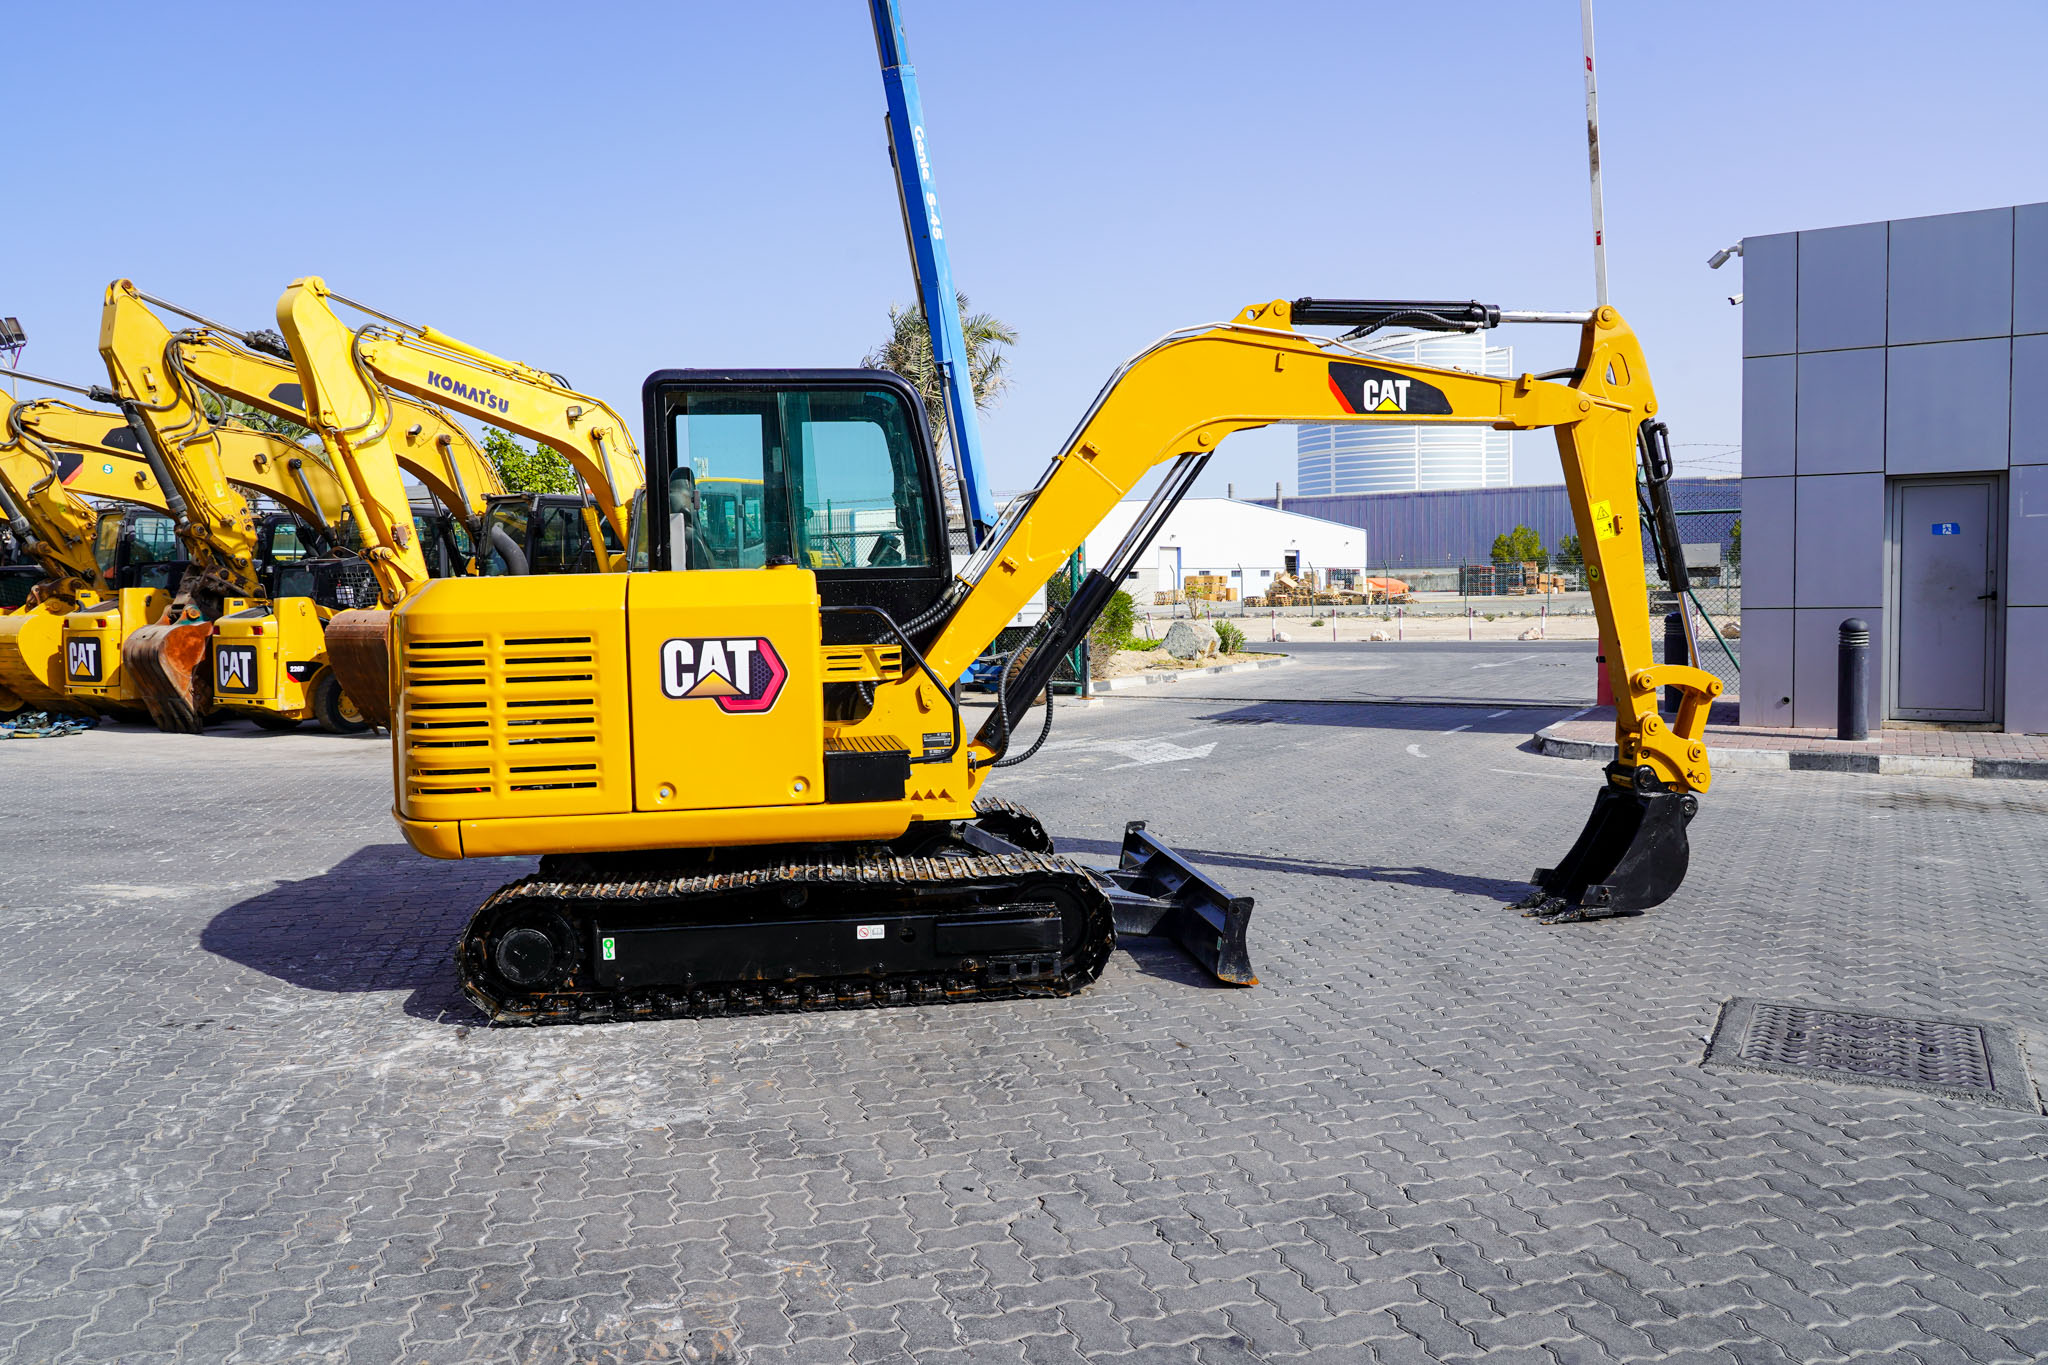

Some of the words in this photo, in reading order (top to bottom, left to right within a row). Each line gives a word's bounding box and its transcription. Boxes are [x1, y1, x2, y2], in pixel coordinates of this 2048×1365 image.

[914, 125, 930, 181] Genie
[926, 191, 943, 240] S-45
[427, 370, 509, 413] KOMATSU
[1363, 379, 1411, 411] CAT
[68, 641, 97, 677] CAT
[219, 650, 252, 688] CAT
[662, 639, 757, 697] CAT
